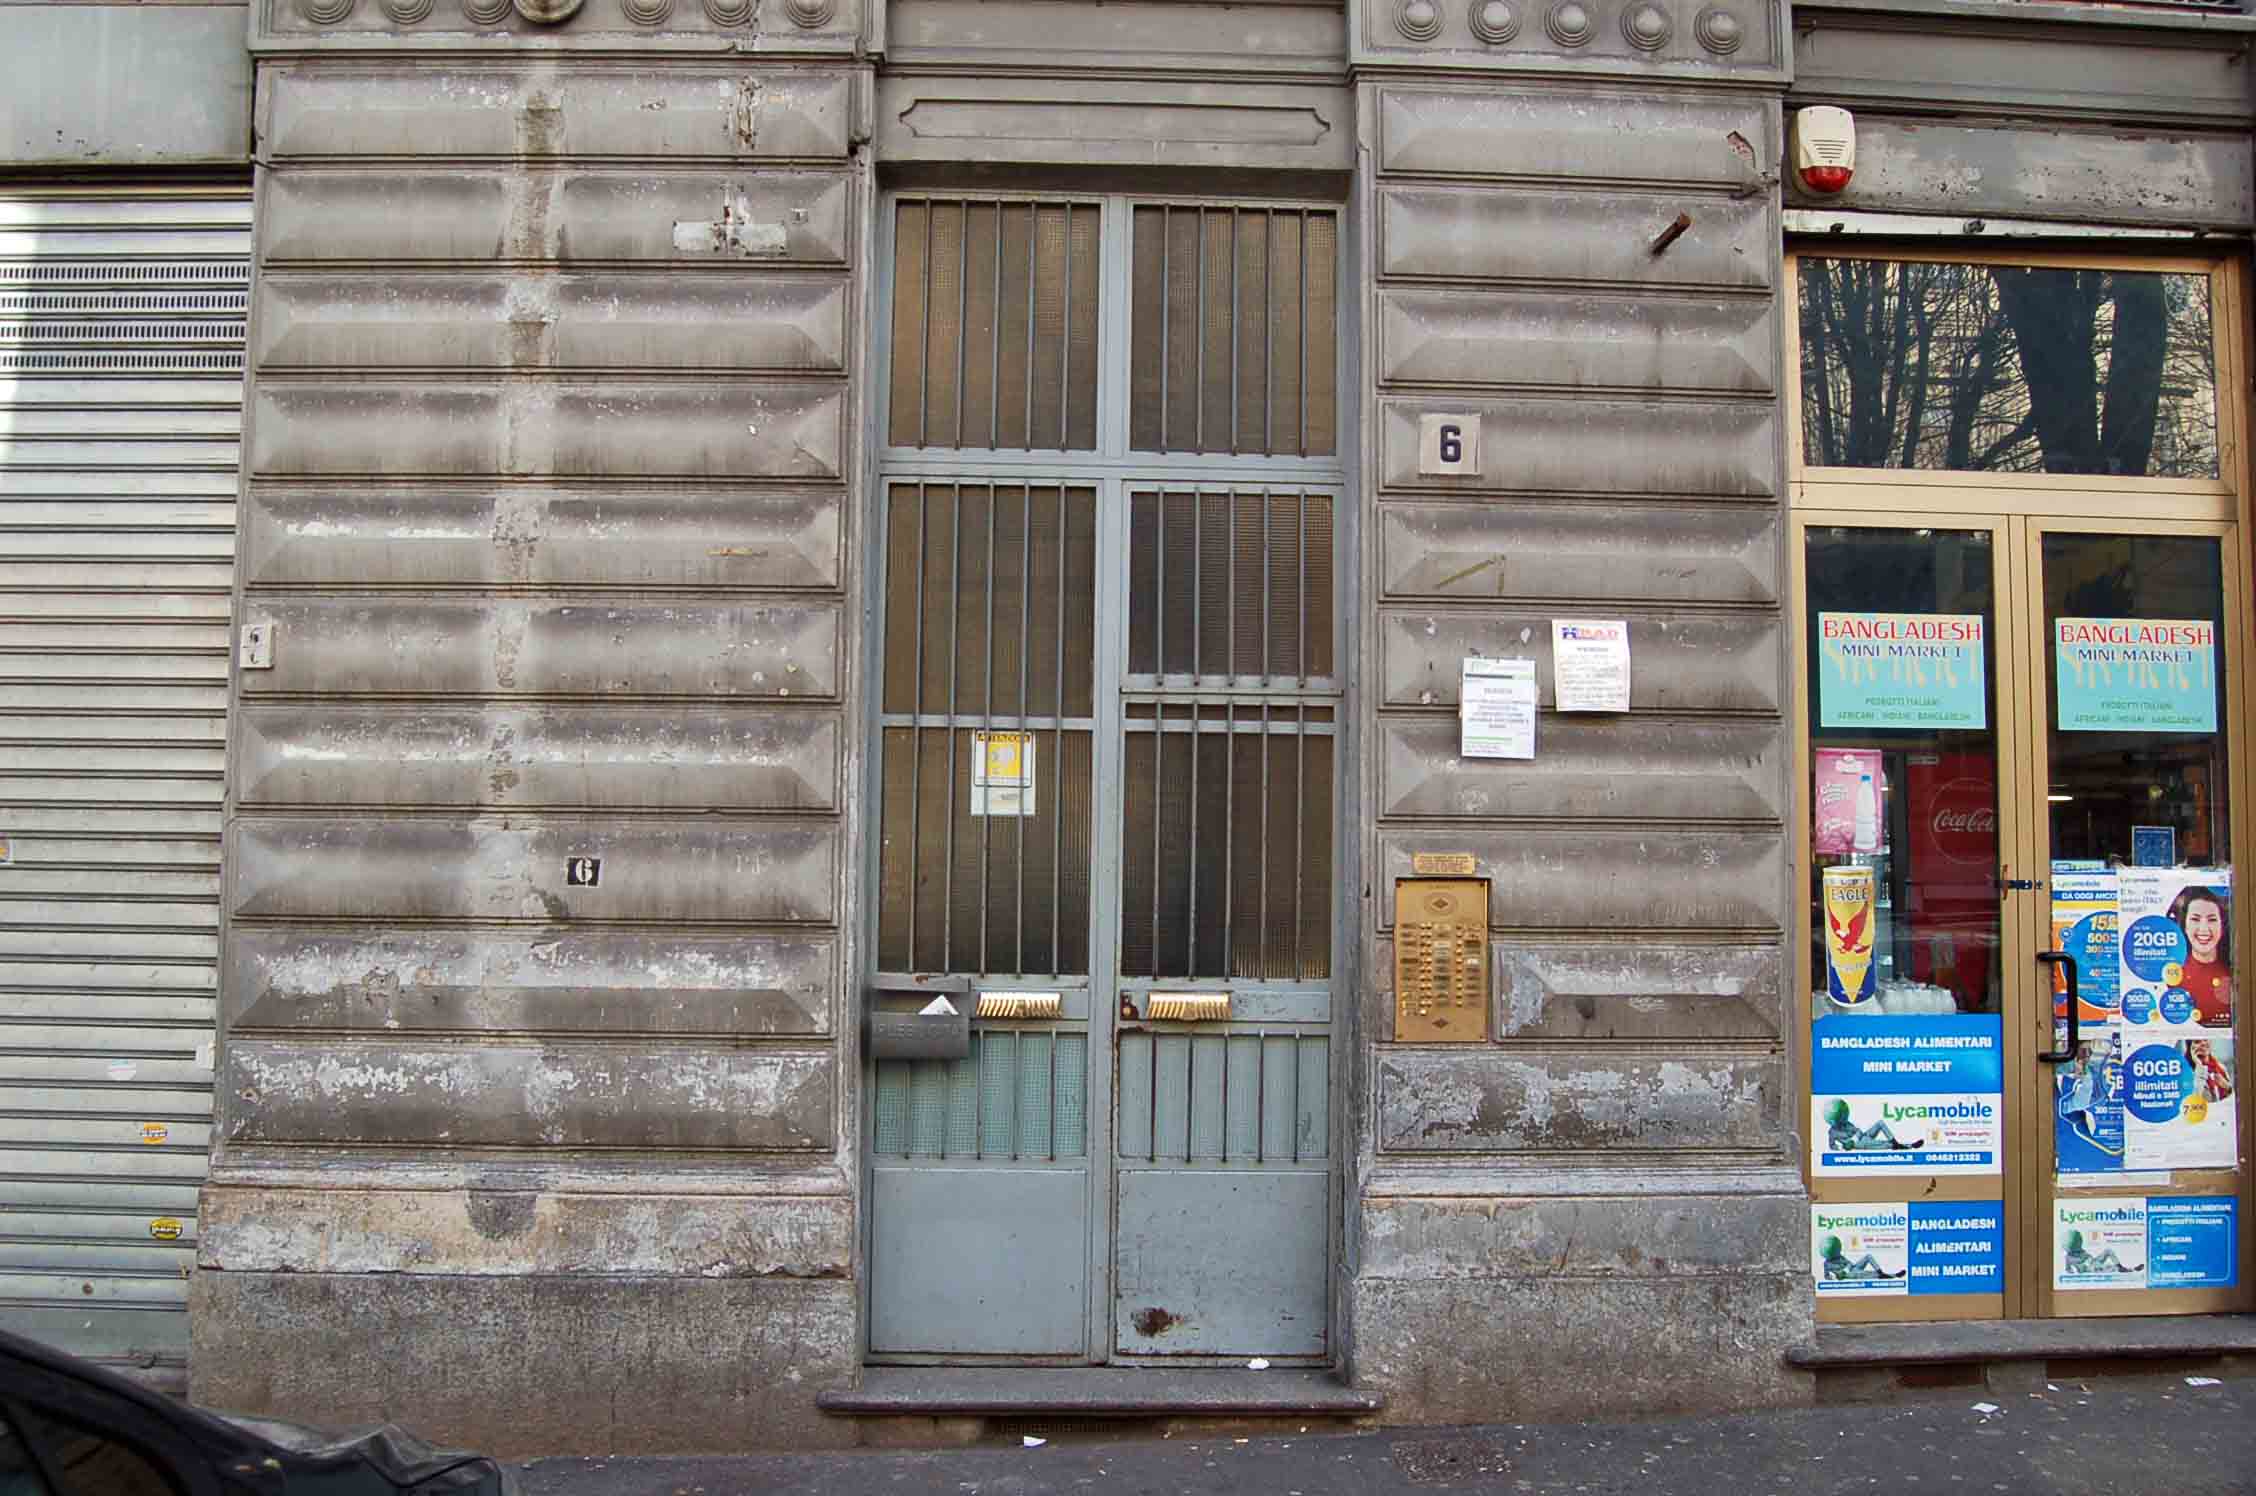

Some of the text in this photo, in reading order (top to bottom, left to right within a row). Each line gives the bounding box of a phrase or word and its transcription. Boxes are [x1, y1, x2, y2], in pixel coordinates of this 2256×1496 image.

[1440, 424, 1462, 463] 6
[1823, 619, 1981, 641] BANGLADESH
[2060, 623, 2212, 645] BANGLADESH
[1841, 644, 1962, 658] MINI MARKET
[2078, 648, 2193, 663] MINI MARKET
[575, 859, 593, 882] 6
[1831, 887, 1869, 901] EAGLE
[2133, 932, 2178, 946] 20GB
[1821, 1036, 1993, 1049] BANGLADESH ALIMENTARI
[1863, 1061, 1952, 1073] MINI MARKET
[2133, 1060, 2182, 1077] 60GB
[2135, 1080, 2178, 1091] illimitati
[1883, 1102, 1993, 1121] Lycamobile
[1818, 1213, 1906, 1230] Lycamobile
[2060, 1208, 2145, 1224] Lycamobile
[1911, 1218, 1996, 1231] BANGLADESH
[1915, 1241, 1992, 1254] ALIMENTARI
[1911, 1264, 1997, 1277] MINI MARKET
